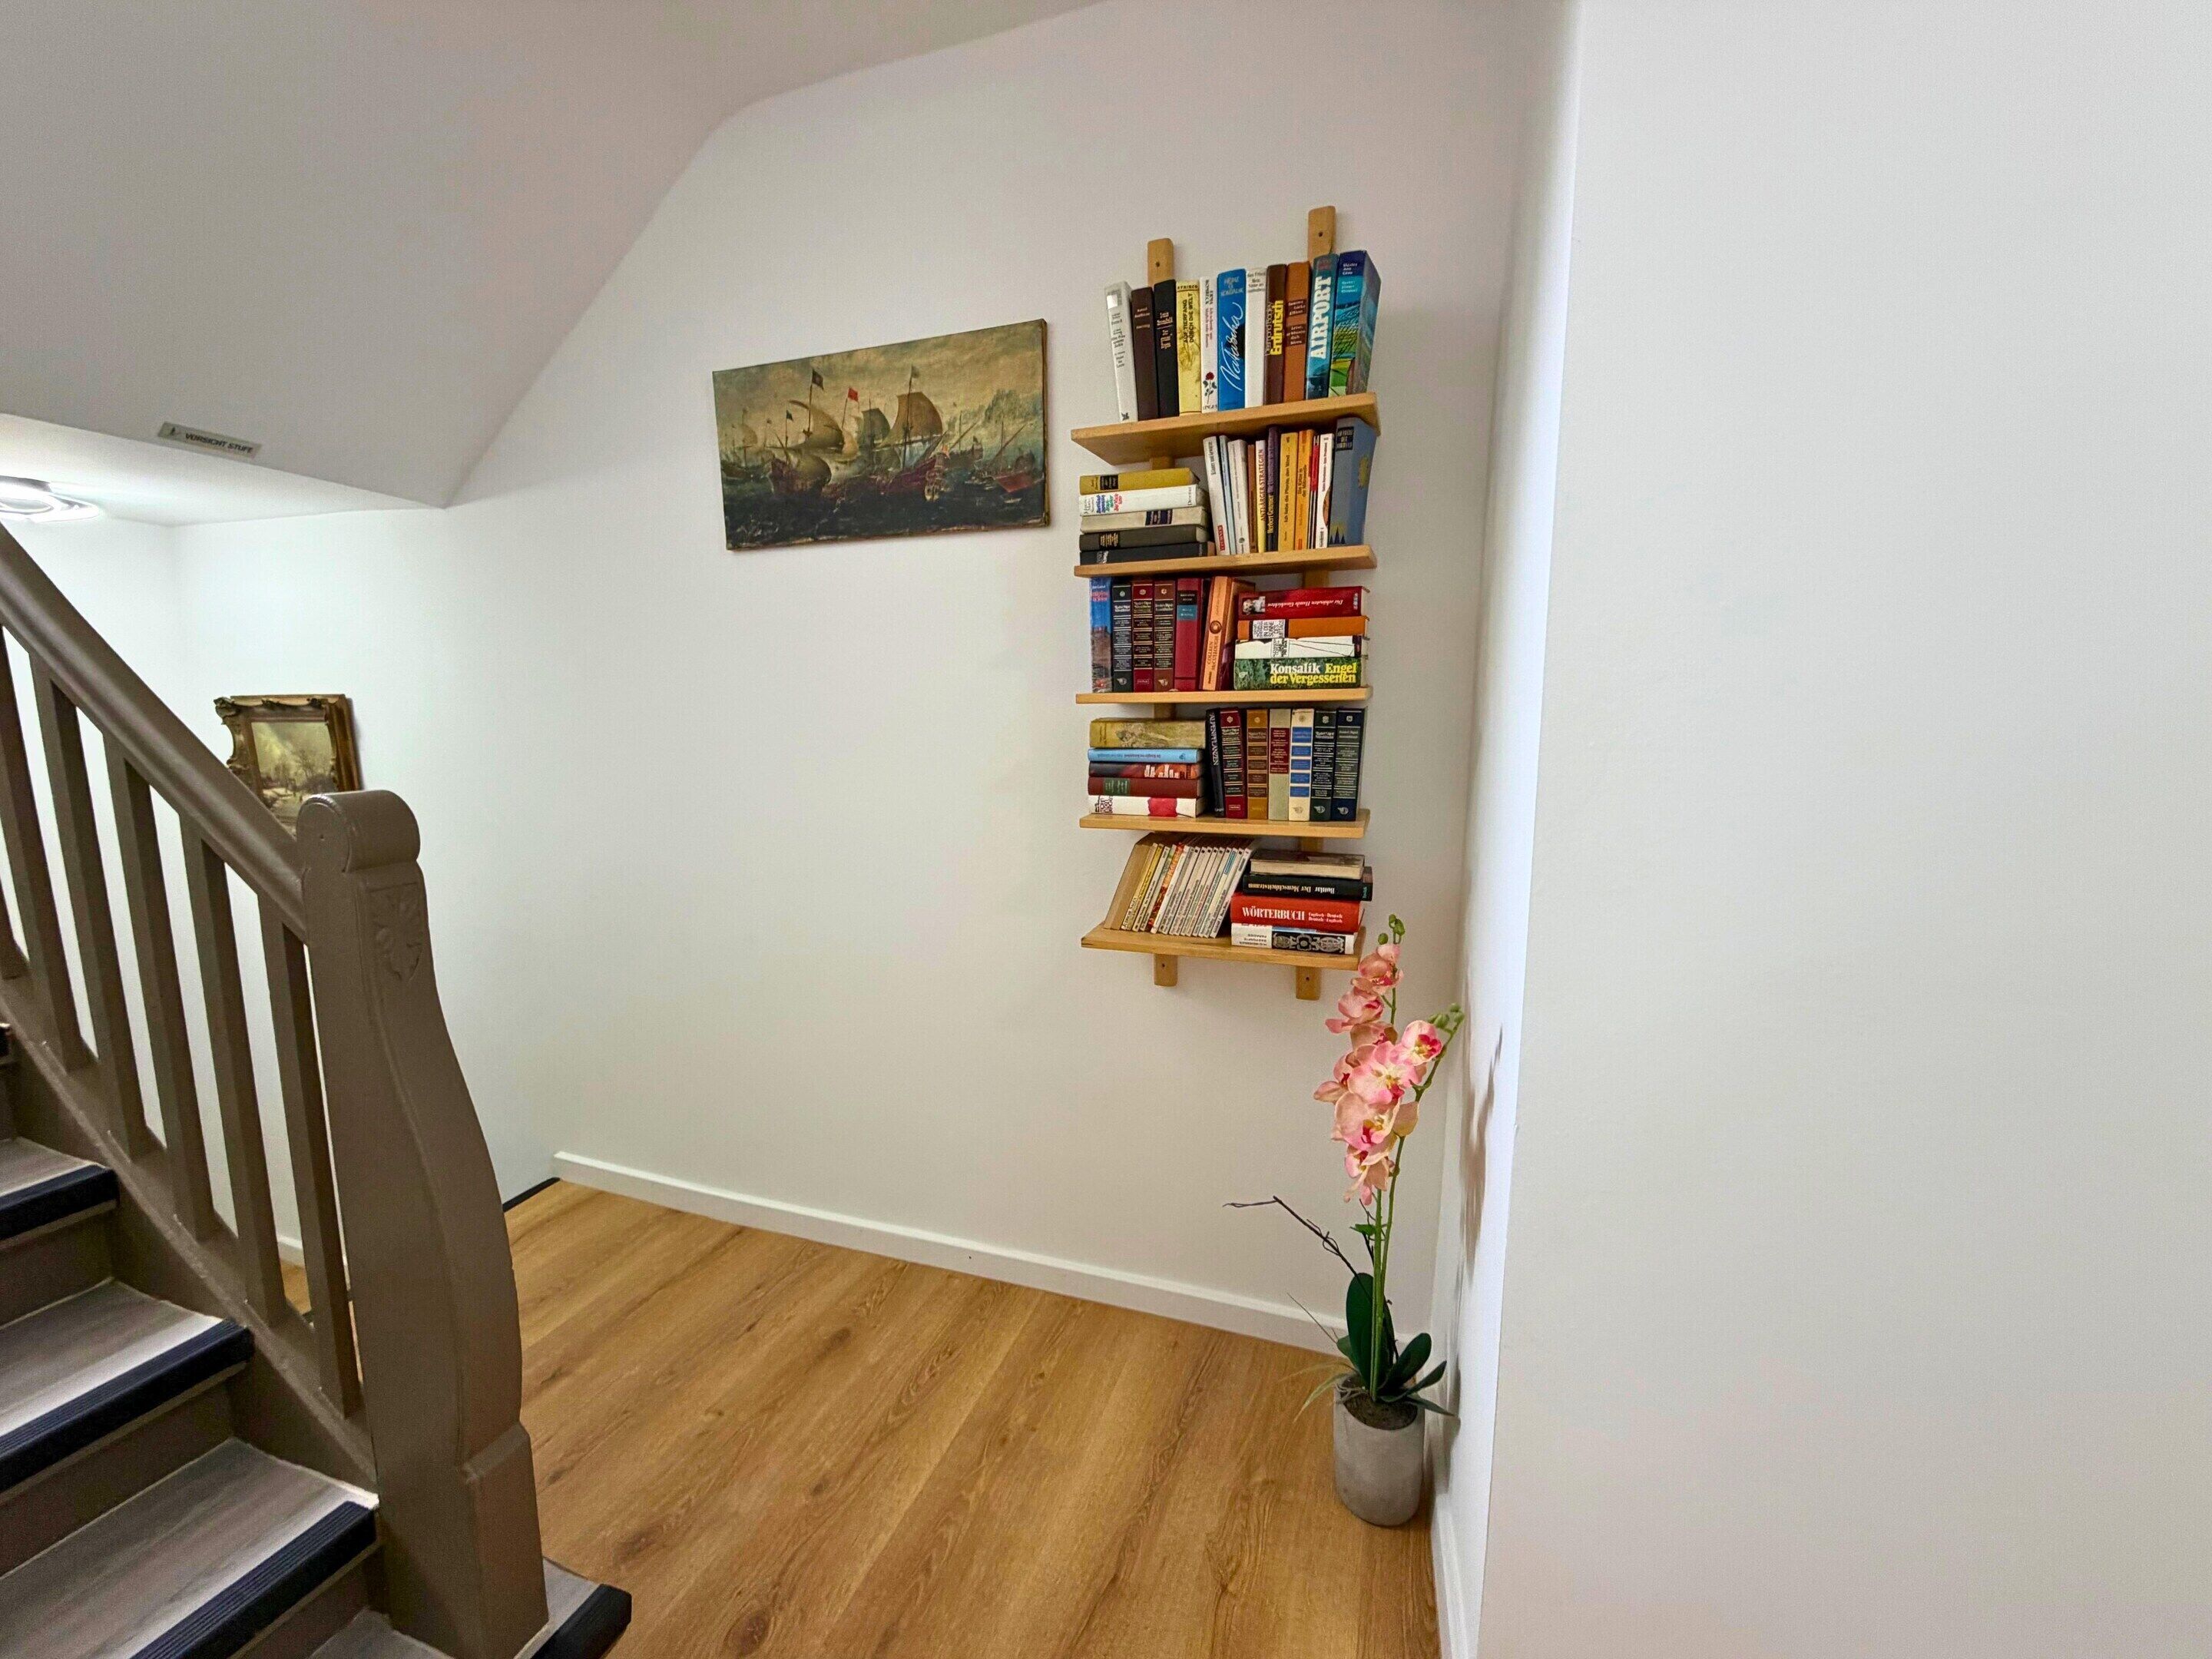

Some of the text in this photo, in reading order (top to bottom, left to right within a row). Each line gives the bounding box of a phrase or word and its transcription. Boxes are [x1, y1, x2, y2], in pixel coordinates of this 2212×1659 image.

[1310, 275, 1333, 360] AIRPORT
[1269, 300, 1284, 356] Erdrutsch
[185, 432, 228, 447] VORSICHT
[1270, 662, 1357, 676] Konsalik Engel
[1270, 673, 1356, 686] der Vergessenen
[1301, 885, 1312, 893] Der
[1241, 906, 1306, 922] WÖRTERBUCH
